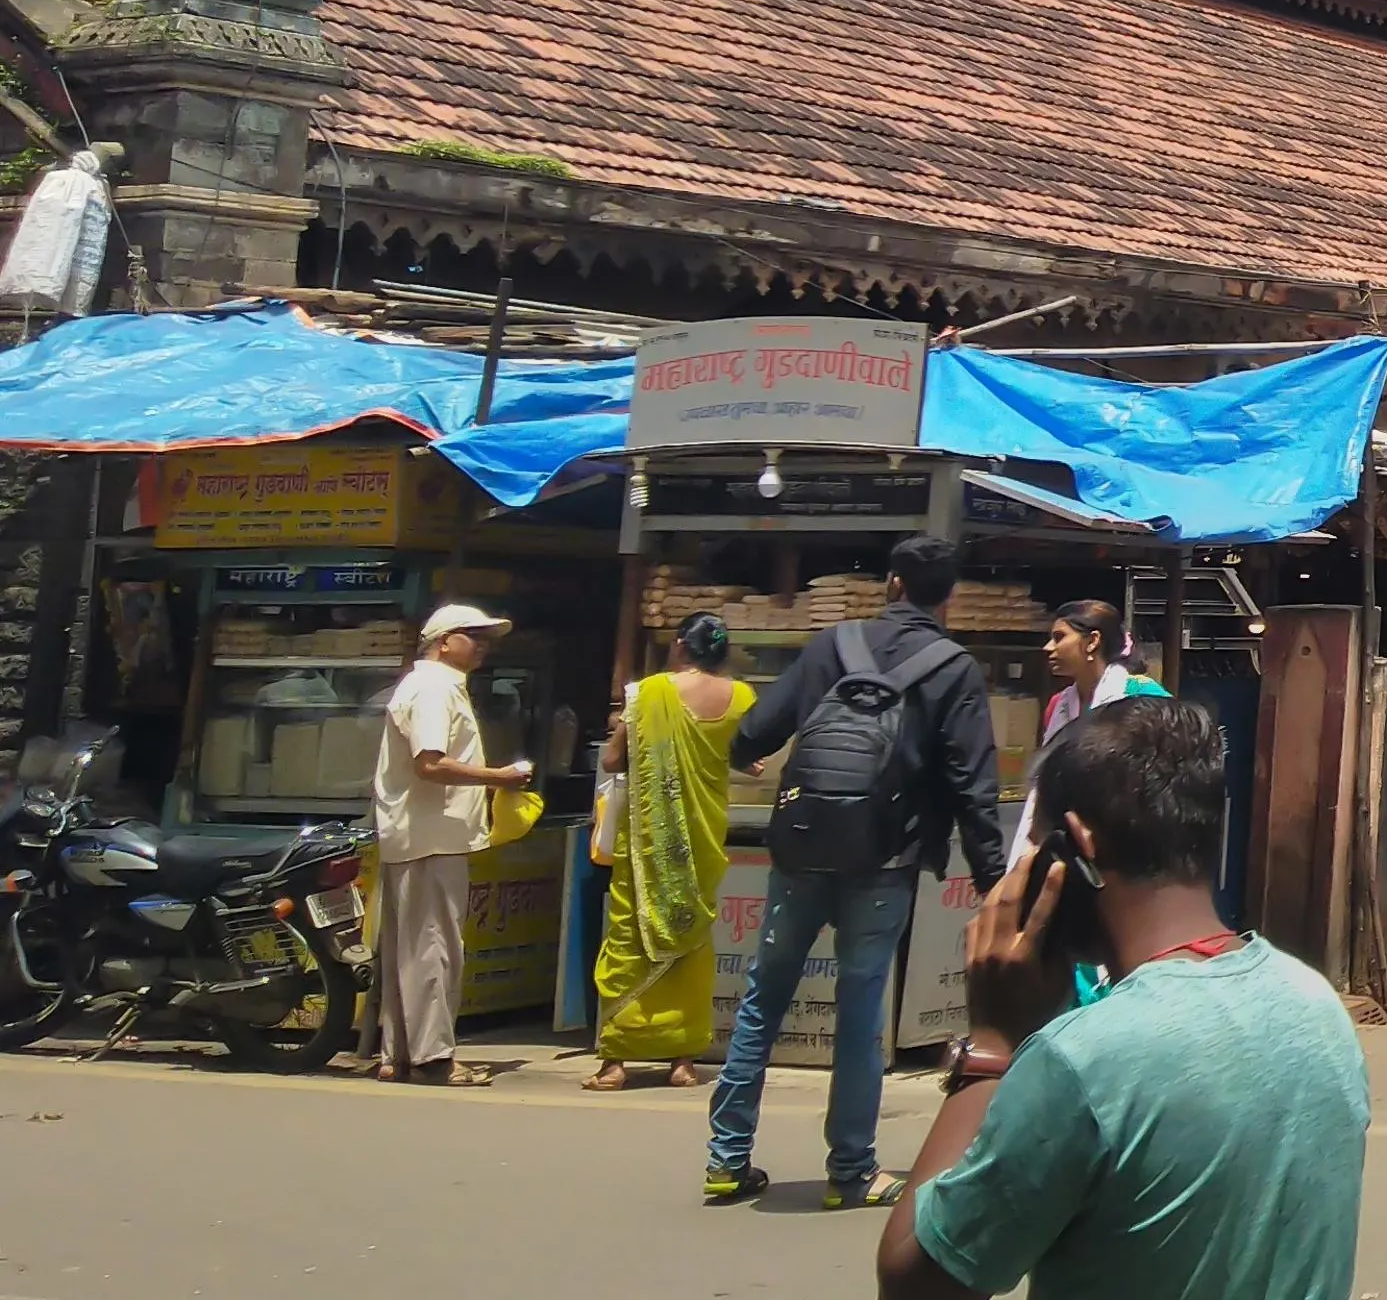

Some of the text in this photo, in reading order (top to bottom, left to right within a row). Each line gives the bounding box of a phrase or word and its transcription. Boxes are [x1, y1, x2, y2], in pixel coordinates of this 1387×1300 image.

[641, 341, 912, 392] महाराष्ट्र गुडदाणीवाले
[196, 474, 249, 501] महाराष्ट्र
